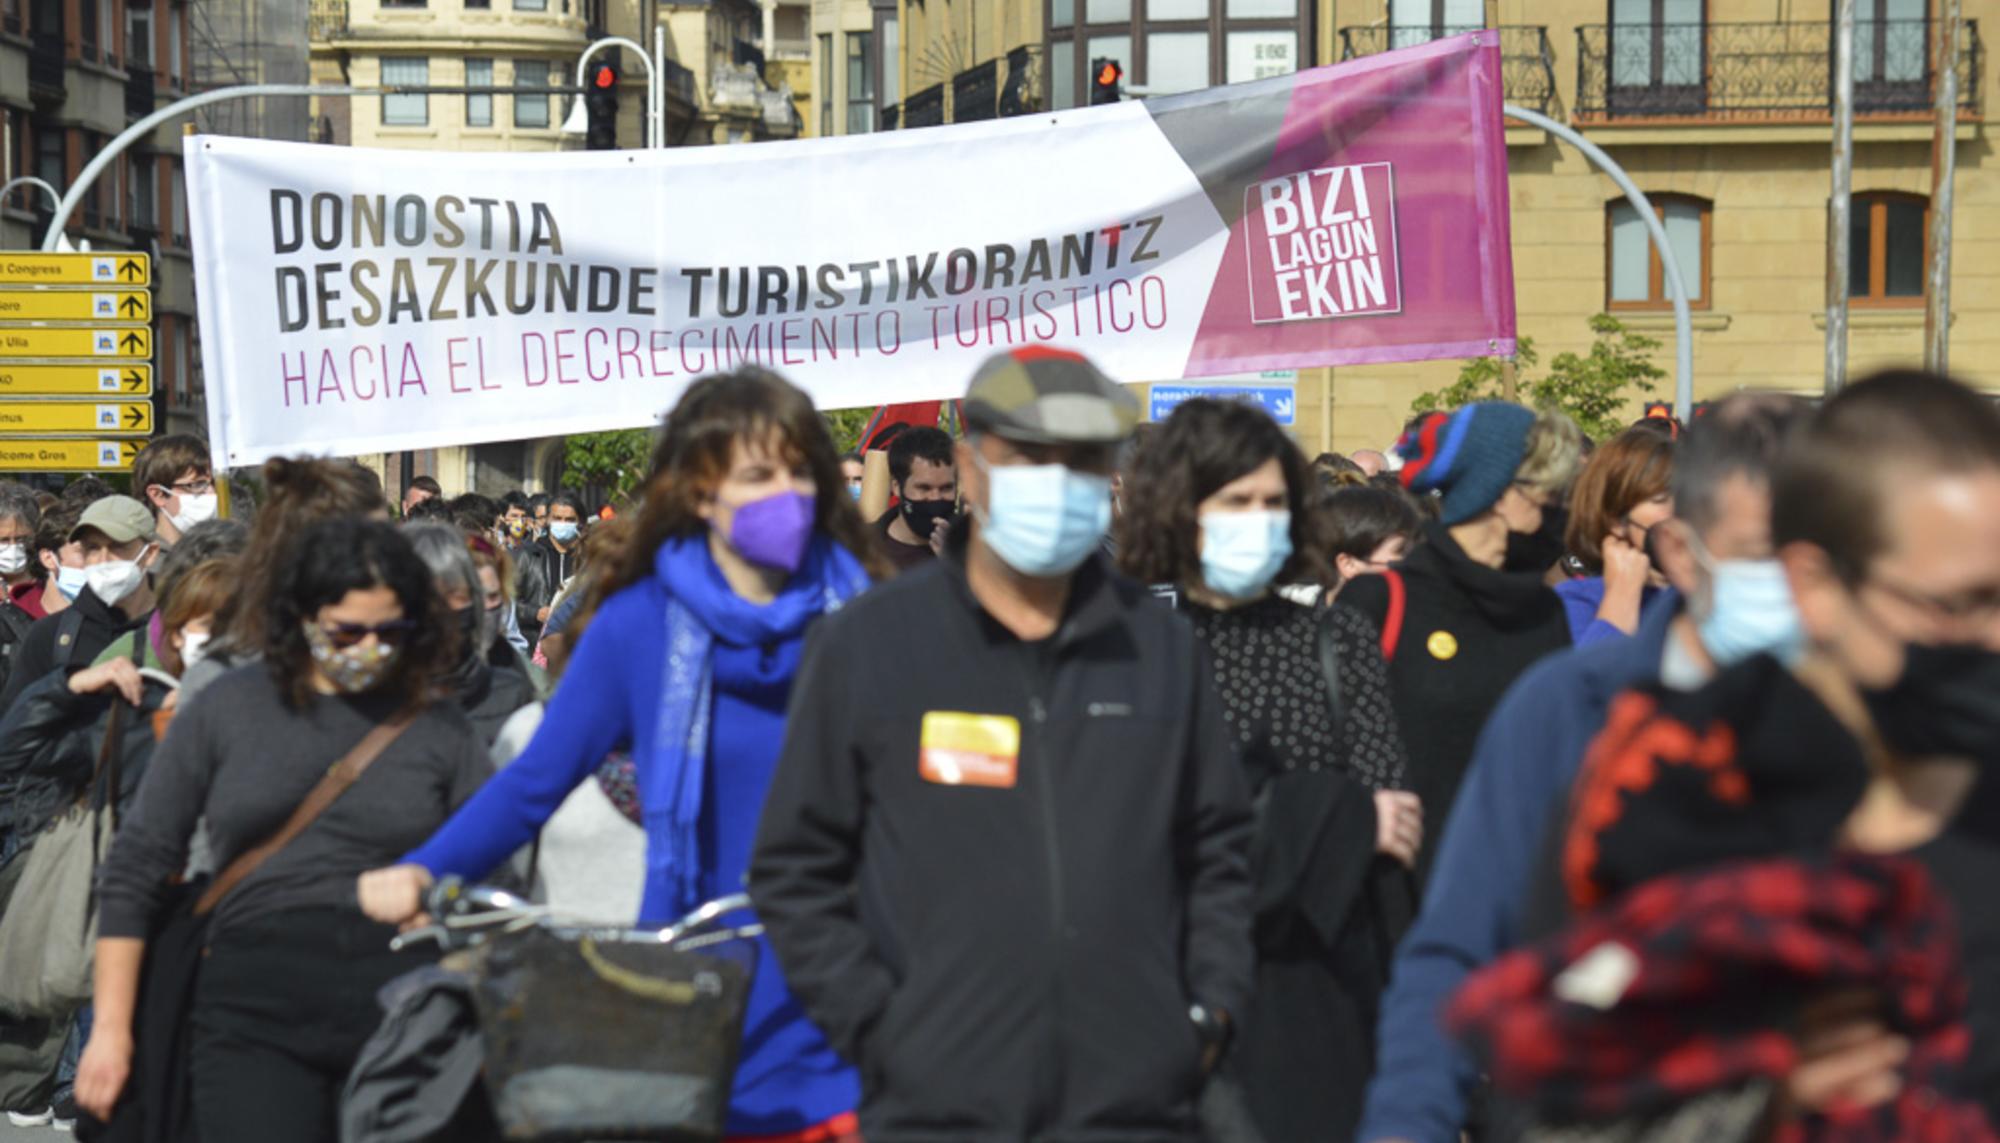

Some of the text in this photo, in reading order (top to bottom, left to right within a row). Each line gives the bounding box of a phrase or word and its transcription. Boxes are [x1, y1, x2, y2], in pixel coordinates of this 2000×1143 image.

[270, 189, 563, 255] DONOSTIA
[1260, 165, 1370, 236] BIZI
[7, 263, 62, 276] Congress
[275, 215, 1164, 333] DESAZKUNDE TURISTIKORANTZ
[1269, 218, 1378, 272] LAGUN
[1276, 255, 1387, 321] EKIN
[281, 275, 1167, 407] HACIA EL DECRECIMIENTO TURÍSTICO
[38, 449, 67, 461] Gros
